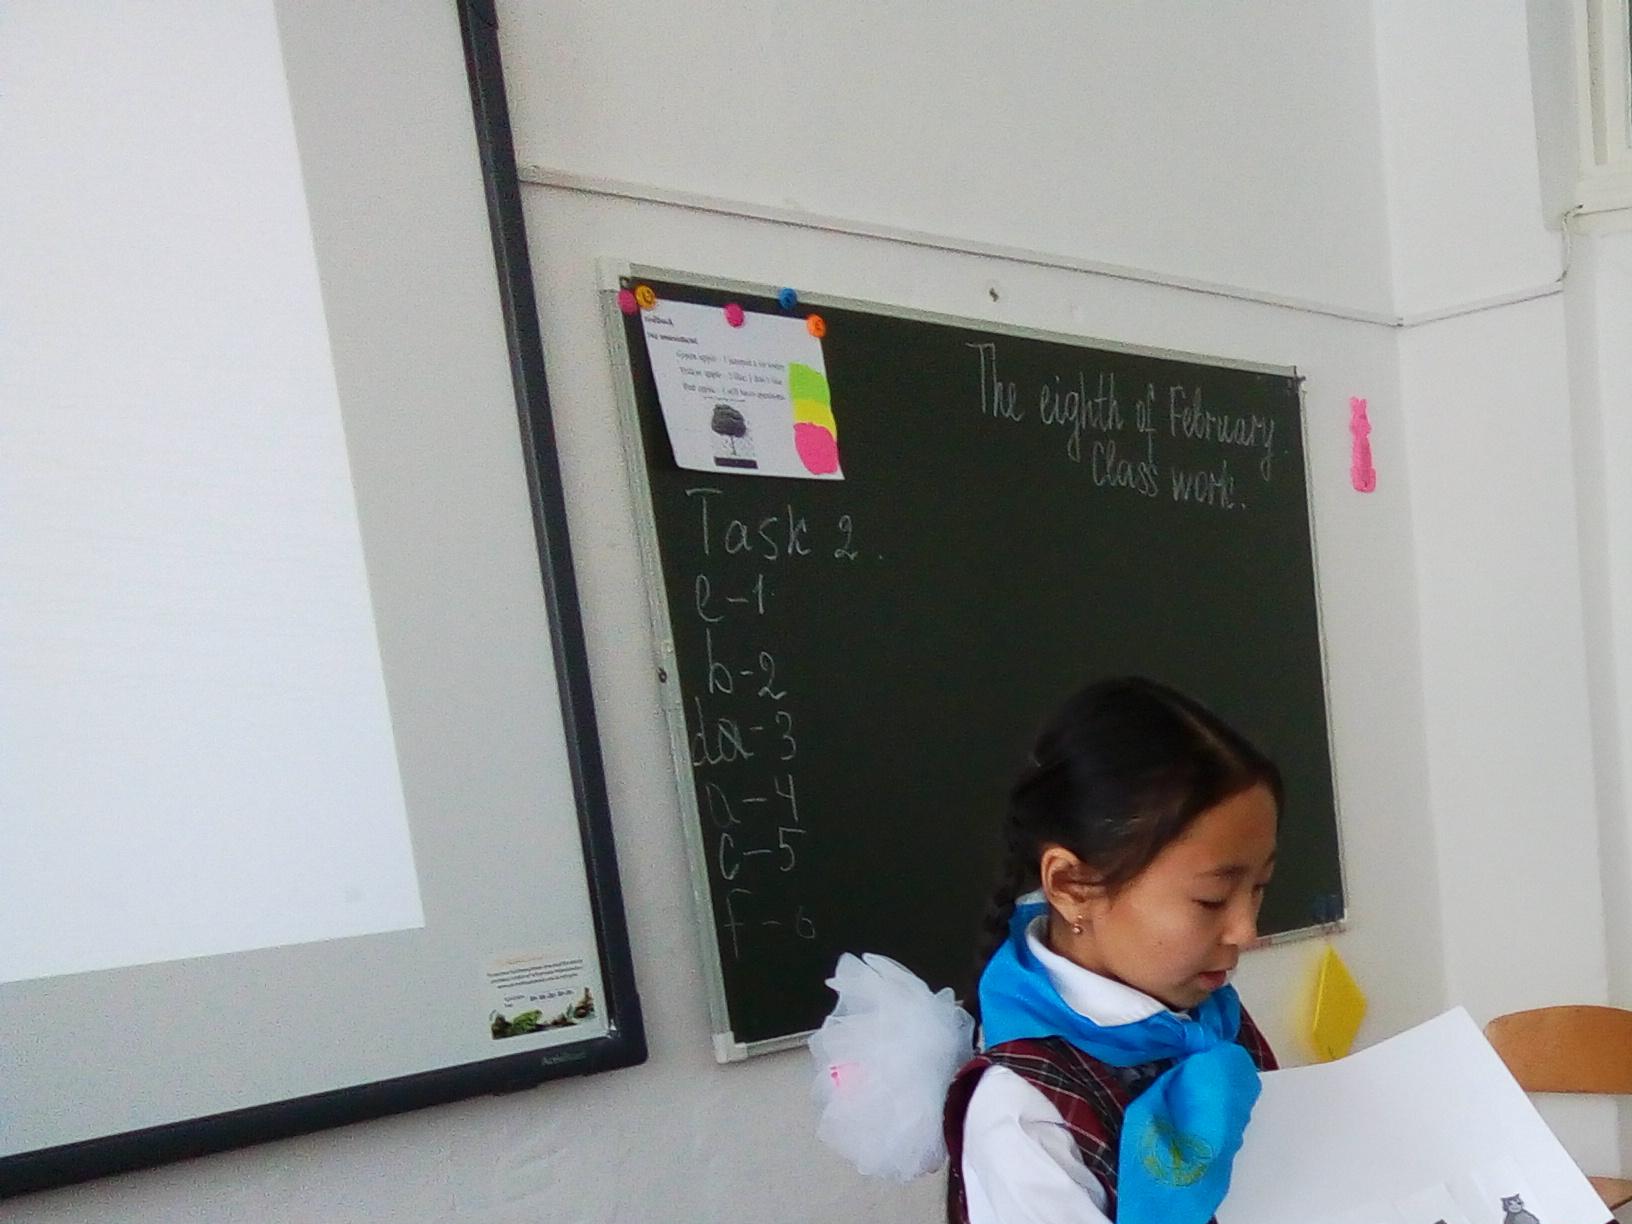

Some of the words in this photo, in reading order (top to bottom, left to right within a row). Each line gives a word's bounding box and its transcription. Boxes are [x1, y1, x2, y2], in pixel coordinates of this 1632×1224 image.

[967, 342, 1024, 423] The
[1040, 372, 1125, 463] eighth
[1136, 383, 1158, 464] of
[1168, 386, 1276, 481] February
[1092, 440, 1159, 497] Class
[685, 487, 812, 560] Task
